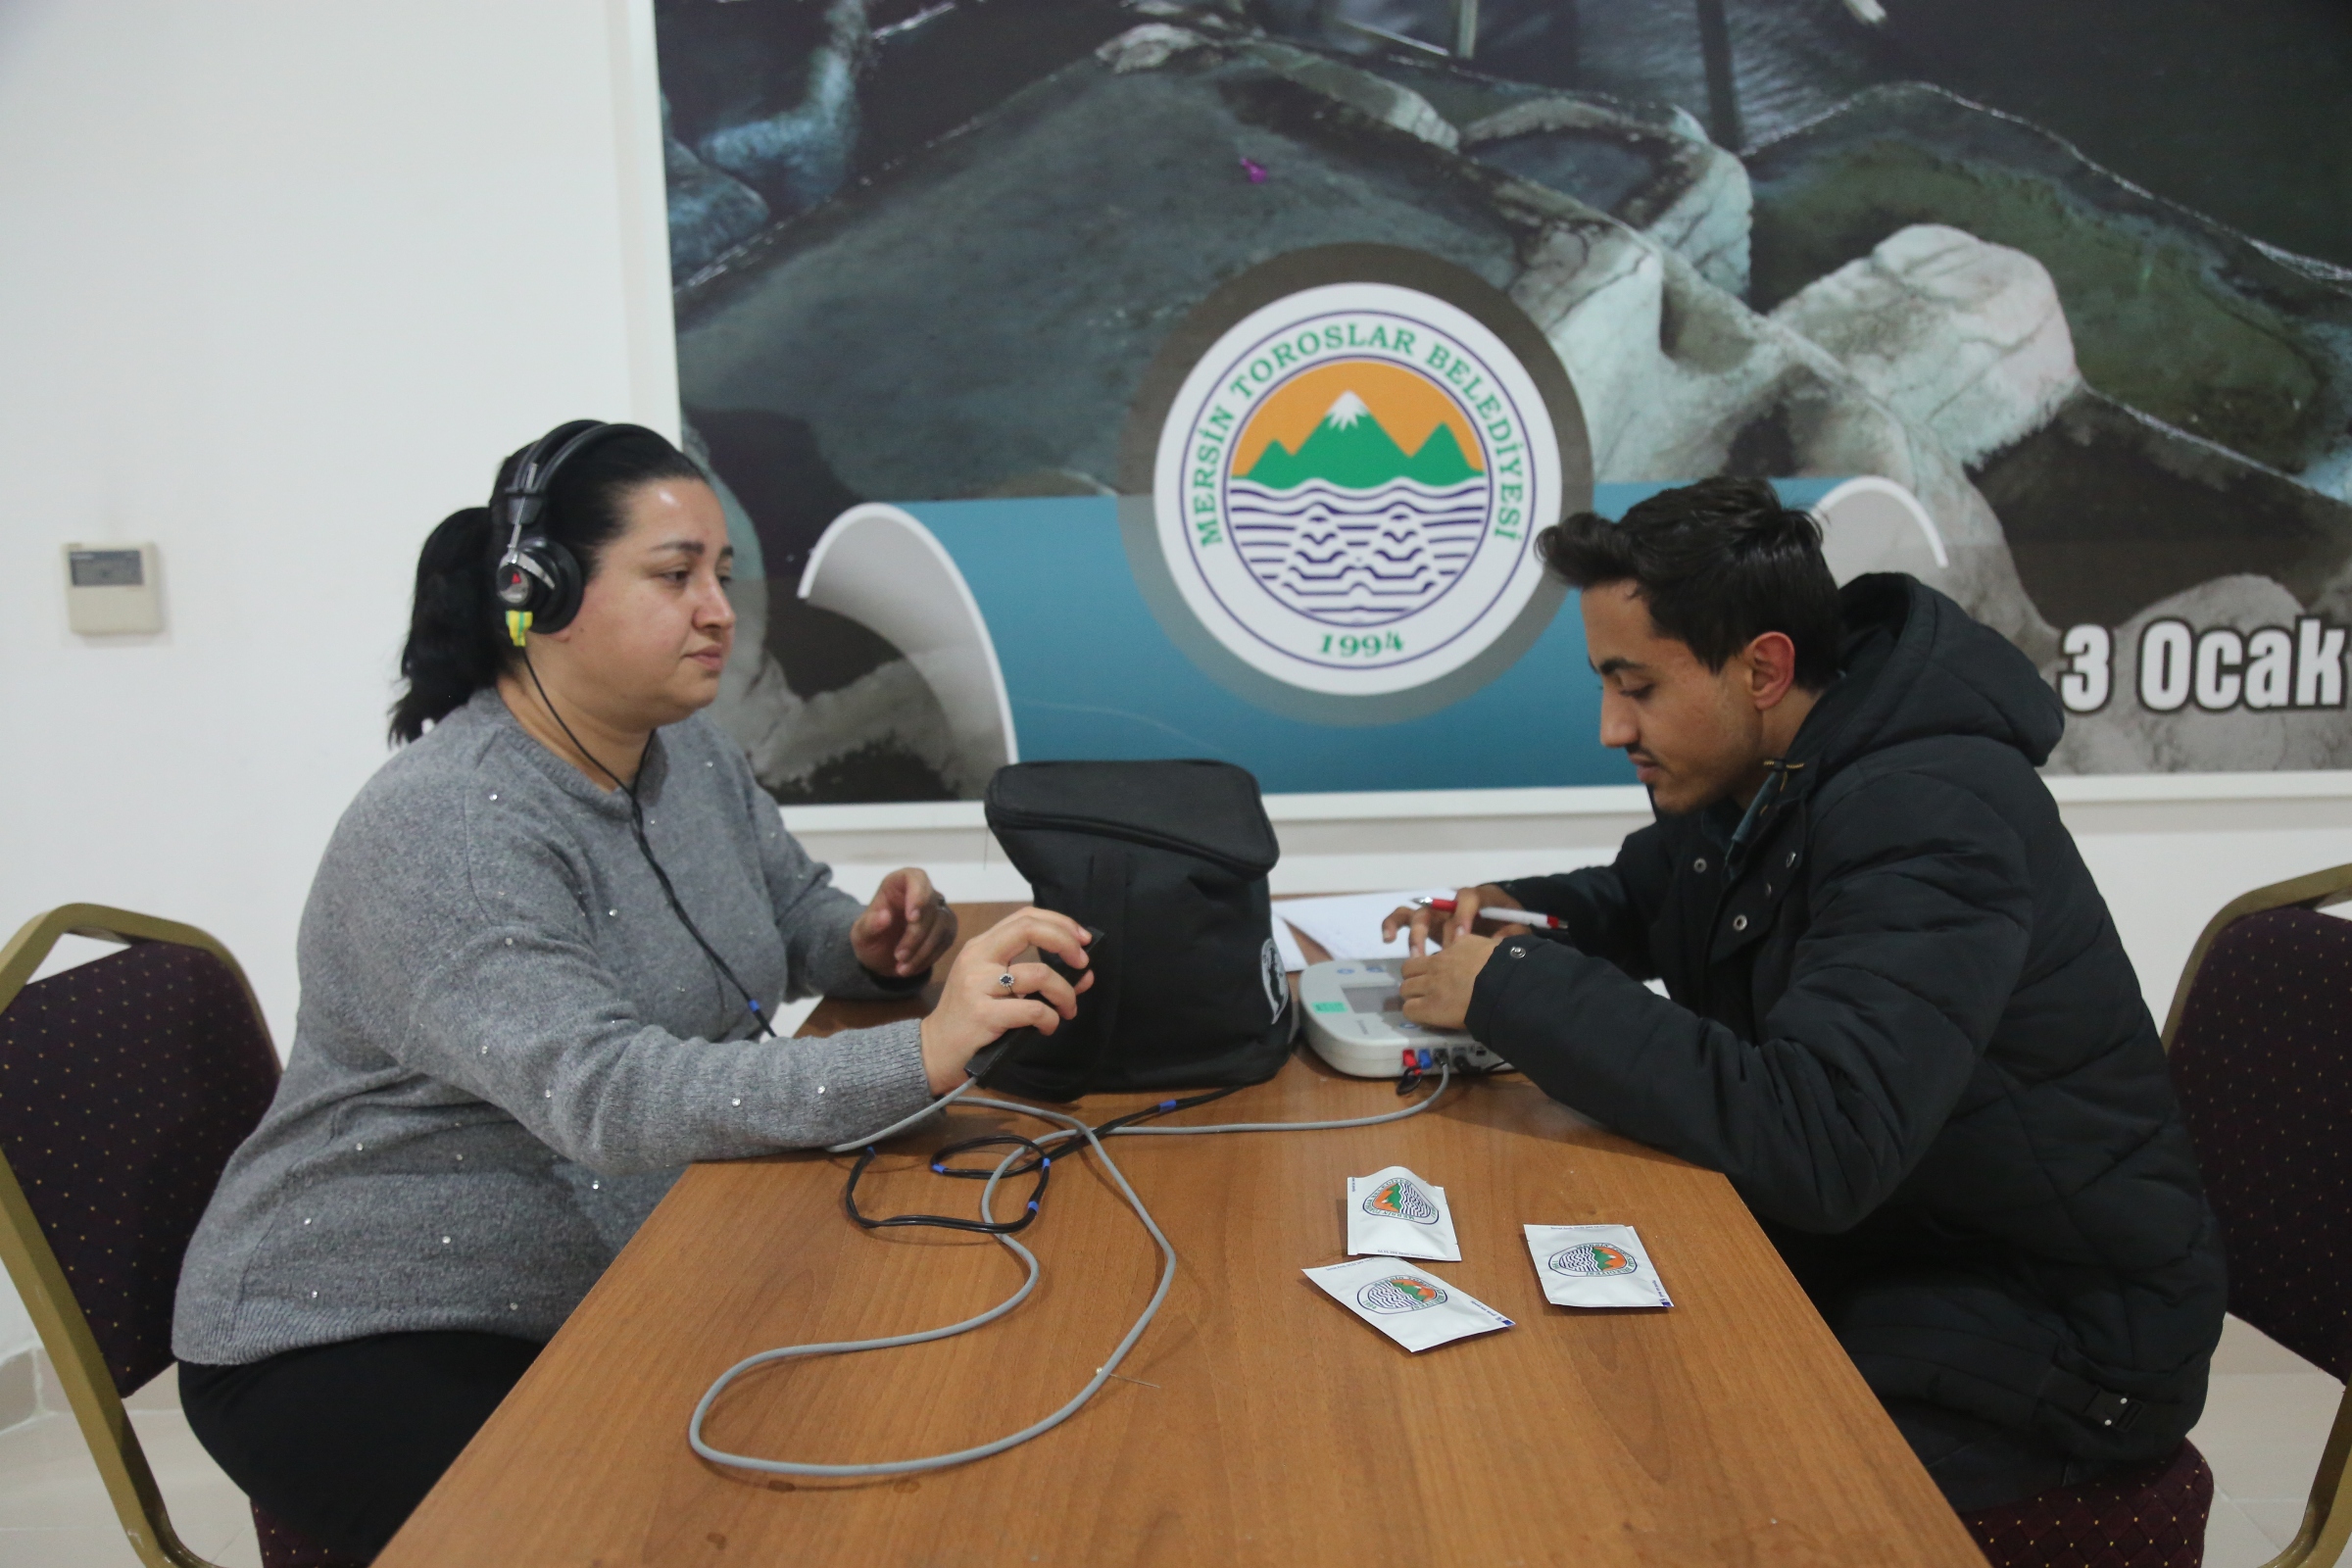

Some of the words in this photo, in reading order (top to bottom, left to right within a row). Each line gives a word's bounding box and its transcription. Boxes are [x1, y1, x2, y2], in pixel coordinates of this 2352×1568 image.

[1193, 404, 1235, 547] MERSİN
[1230, 322, 1417, 401] TOROSLAR
[1425, 343, 1524, 542] BELEDİYESİ
[1319, 631, 1404, 657] 1994
[2059, 621, 2113, 714] 3
[2138, 616, 2348, 713] Ocak
